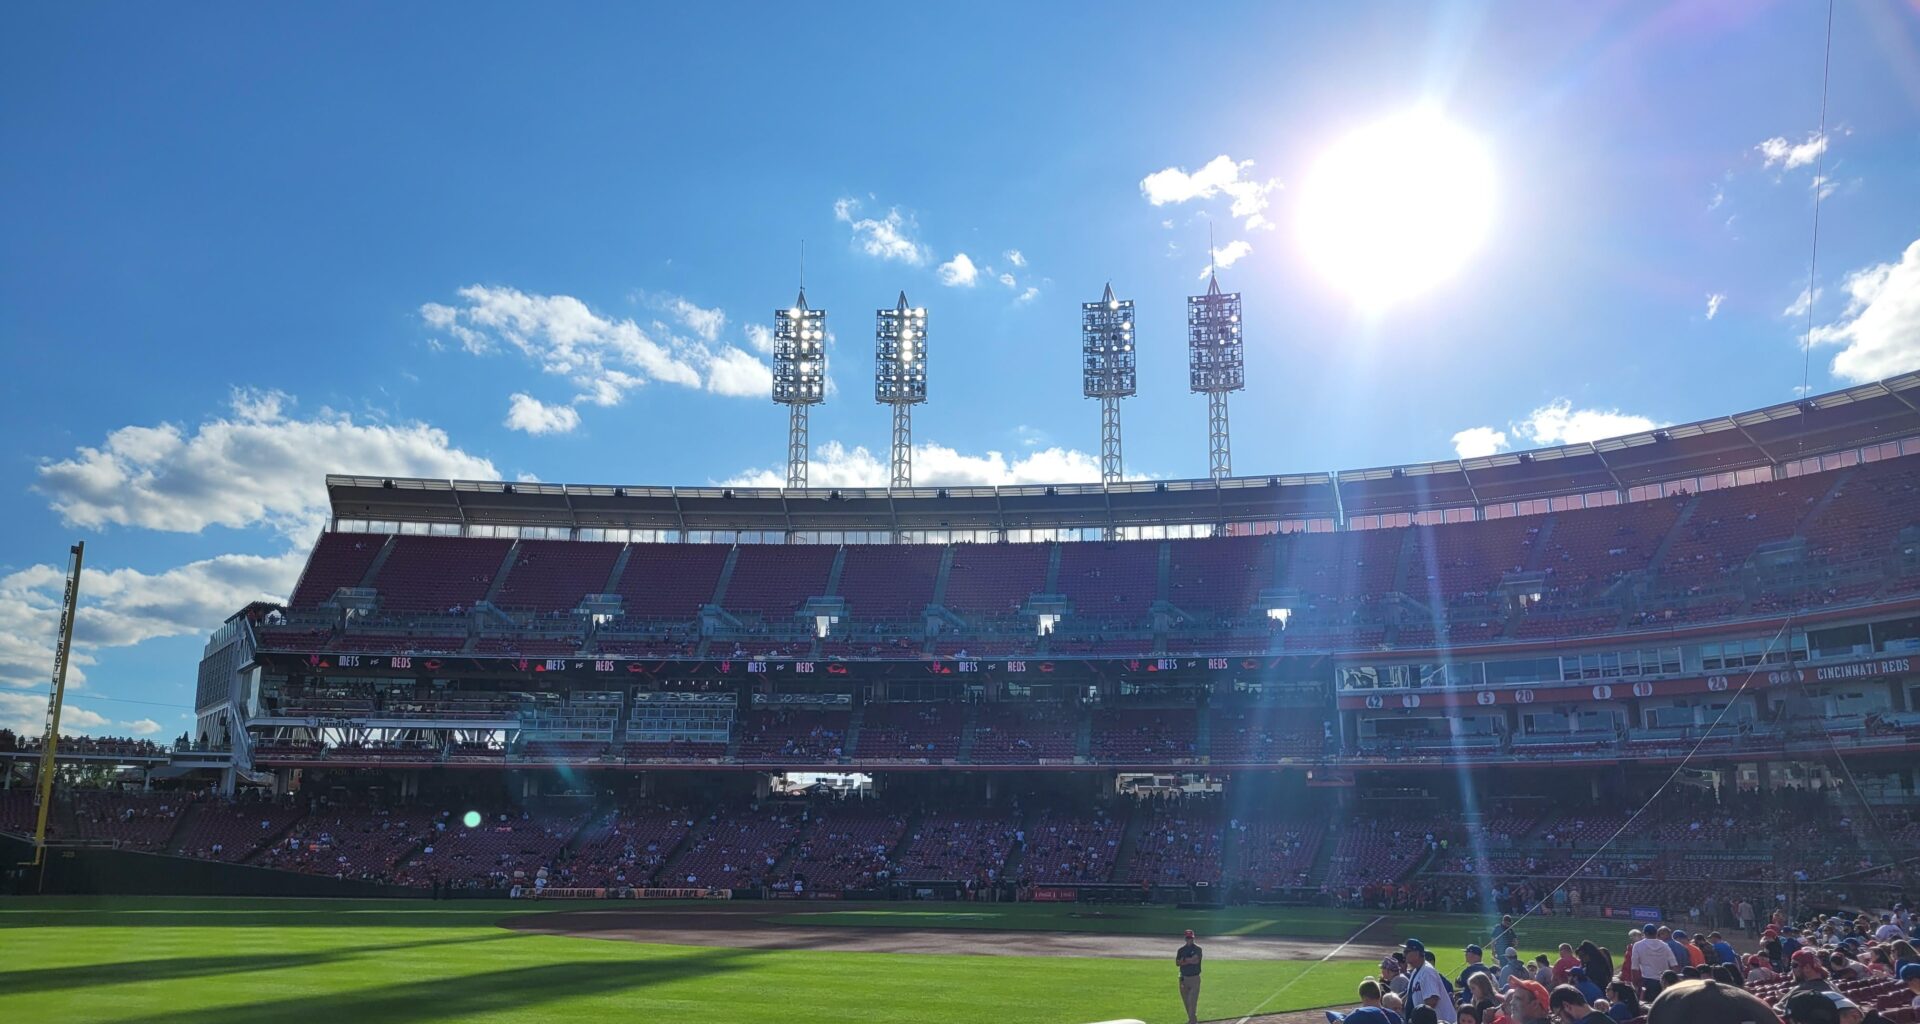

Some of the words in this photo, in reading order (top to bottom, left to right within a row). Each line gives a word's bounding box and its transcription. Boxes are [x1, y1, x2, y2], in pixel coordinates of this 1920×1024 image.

[339, 655, 360, 667] METS
[391, 657, 412, 668] REDS
[545, 660, 566, 671] METS
[595, 660, 614, 671] REDS
[958, 661, 978, 672] METS
[1007, 661, 1026, 672] REDS
[1157, 659, 1178, 670] METS
[1208, 658, 1228, 669] REDS
[747, 662, 767, 673] METS
[796, 662, 815, 673] REDS
[1817, 663, 1878, 680] CINCINNATI
[1881, 659, 1910, 673] REDS
[542, 889, 575, 898] GORILLA
[577, 889, 597, 898] GLUE
[644, 889, 677, 898] GORILLA
[679, 889, 698, 898] TAPE
